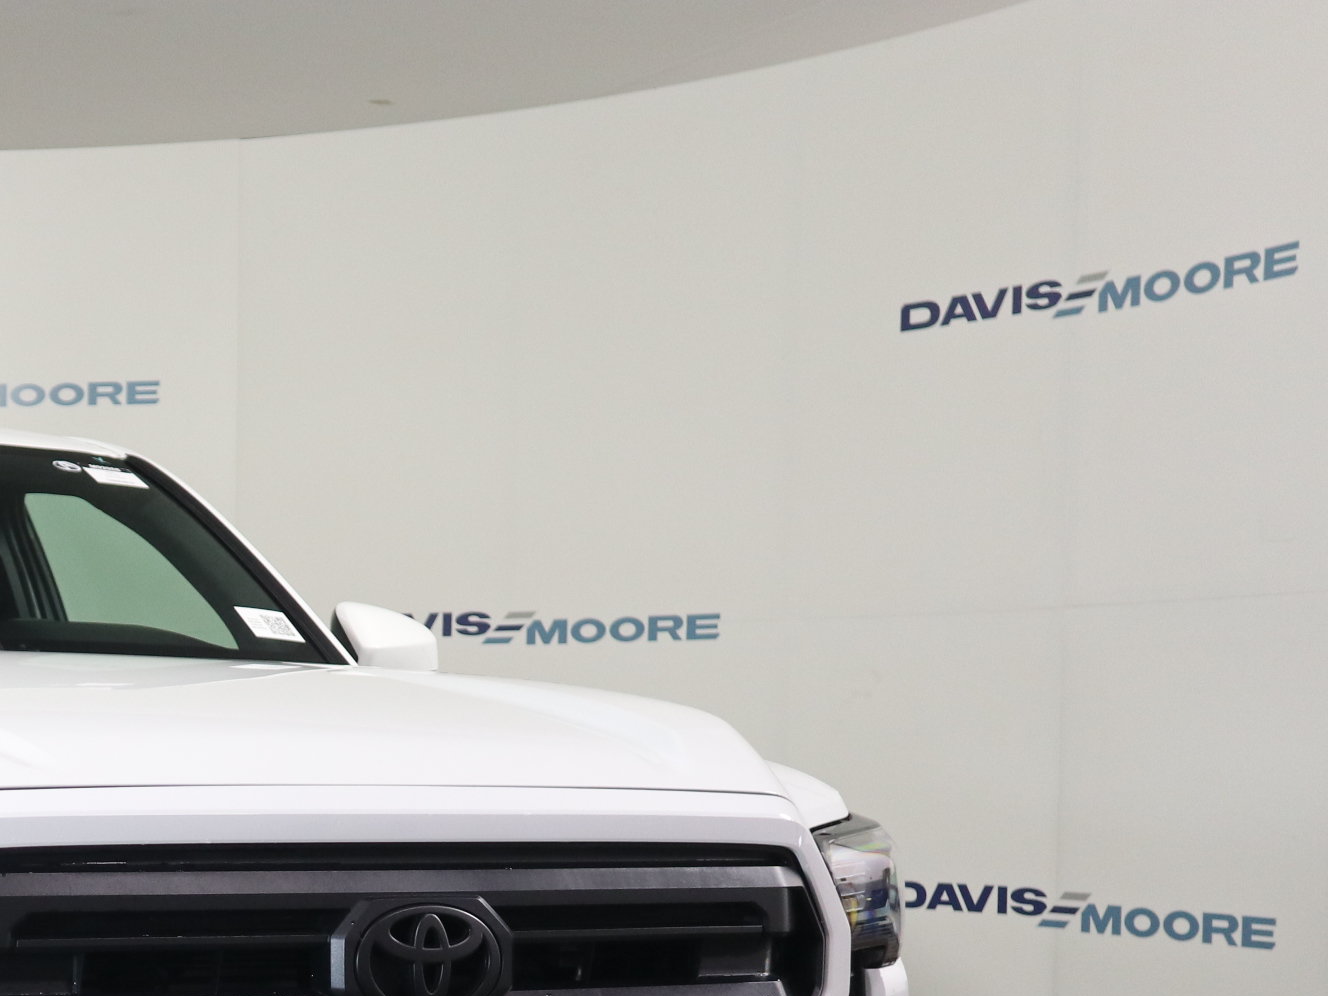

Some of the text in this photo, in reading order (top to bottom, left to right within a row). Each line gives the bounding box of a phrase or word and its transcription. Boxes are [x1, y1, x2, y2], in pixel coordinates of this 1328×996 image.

[900, 240, 1300, 332] DAVIS MOORE
[525, 612, 721, 646] MOORE
[1080, 903, 1278, 951] MOORE
